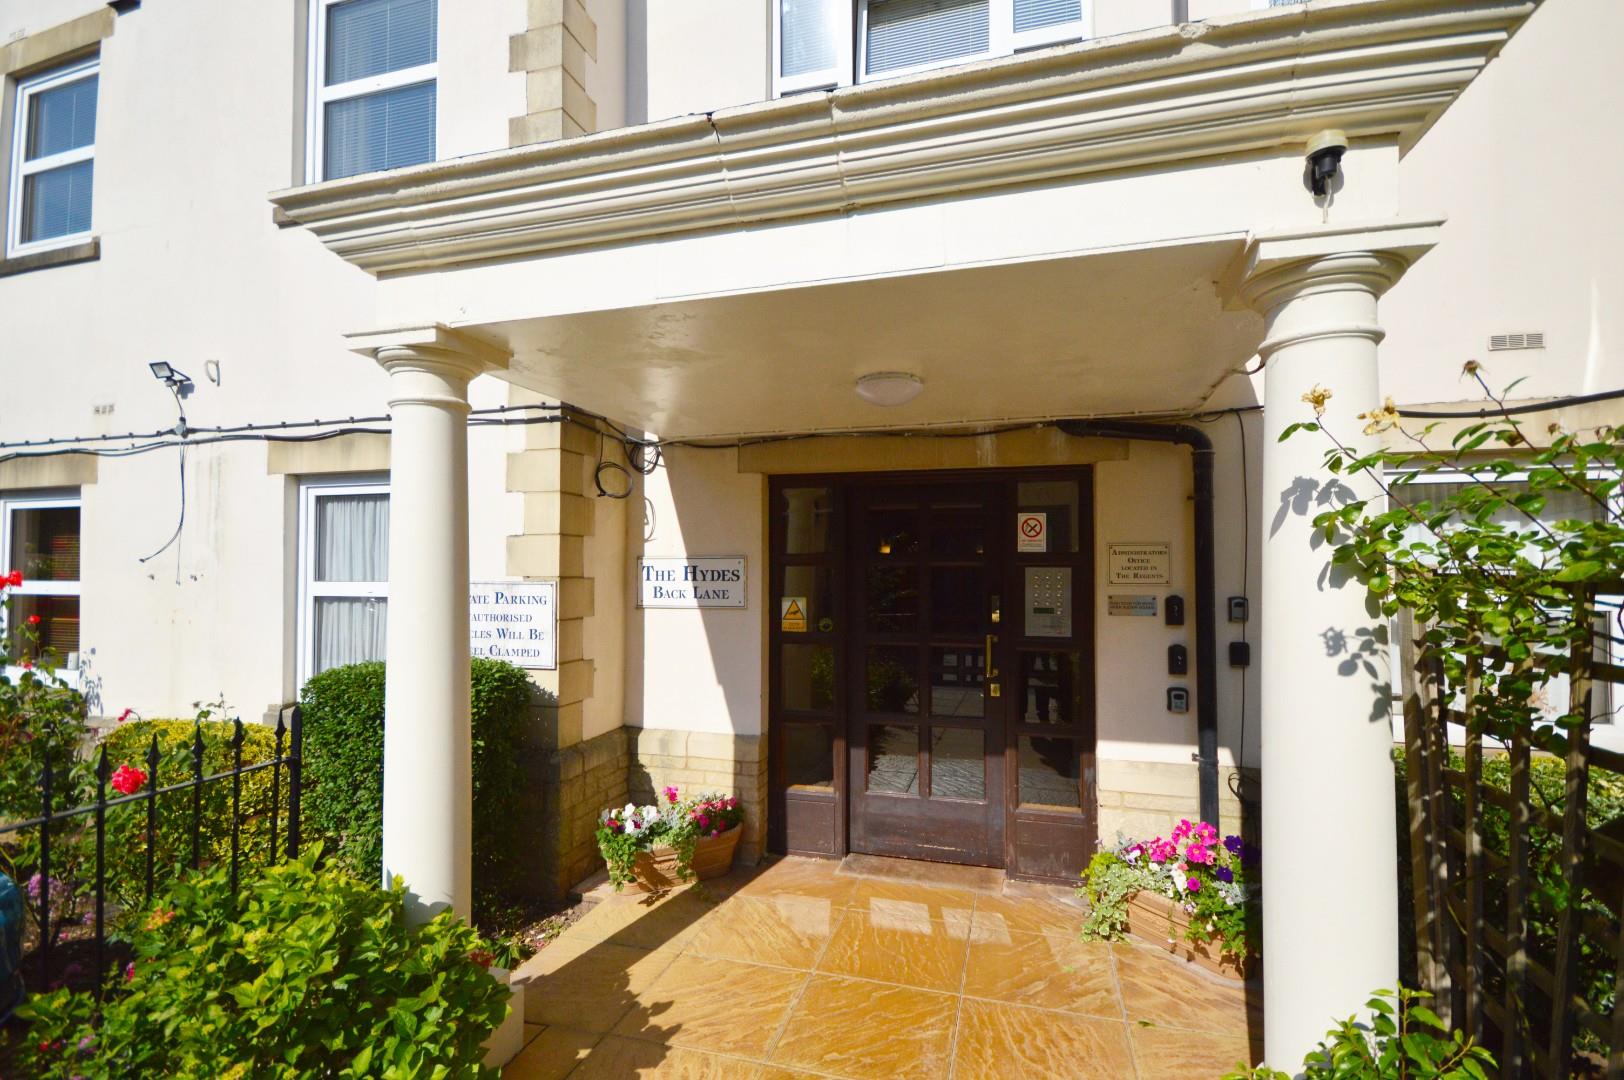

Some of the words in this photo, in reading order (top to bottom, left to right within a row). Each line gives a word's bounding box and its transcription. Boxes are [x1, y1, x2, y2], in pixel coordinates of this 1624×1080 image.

[642, 565, 676, 582] THE
[683, 565, 741, 582] HYDES
[469, 595, 490, 605] ATE
[495, 591, 547, 605] PARKING
[653, 586, 688, 599] BACK
[693, 586, 730, 600] LANE
[472, 613, 533, 623] AUTHORISED
[496, 628, 525, 640] WILL
[529, 628, 545, 640] BE
[489, 644, 540, 657] CLAMPED
